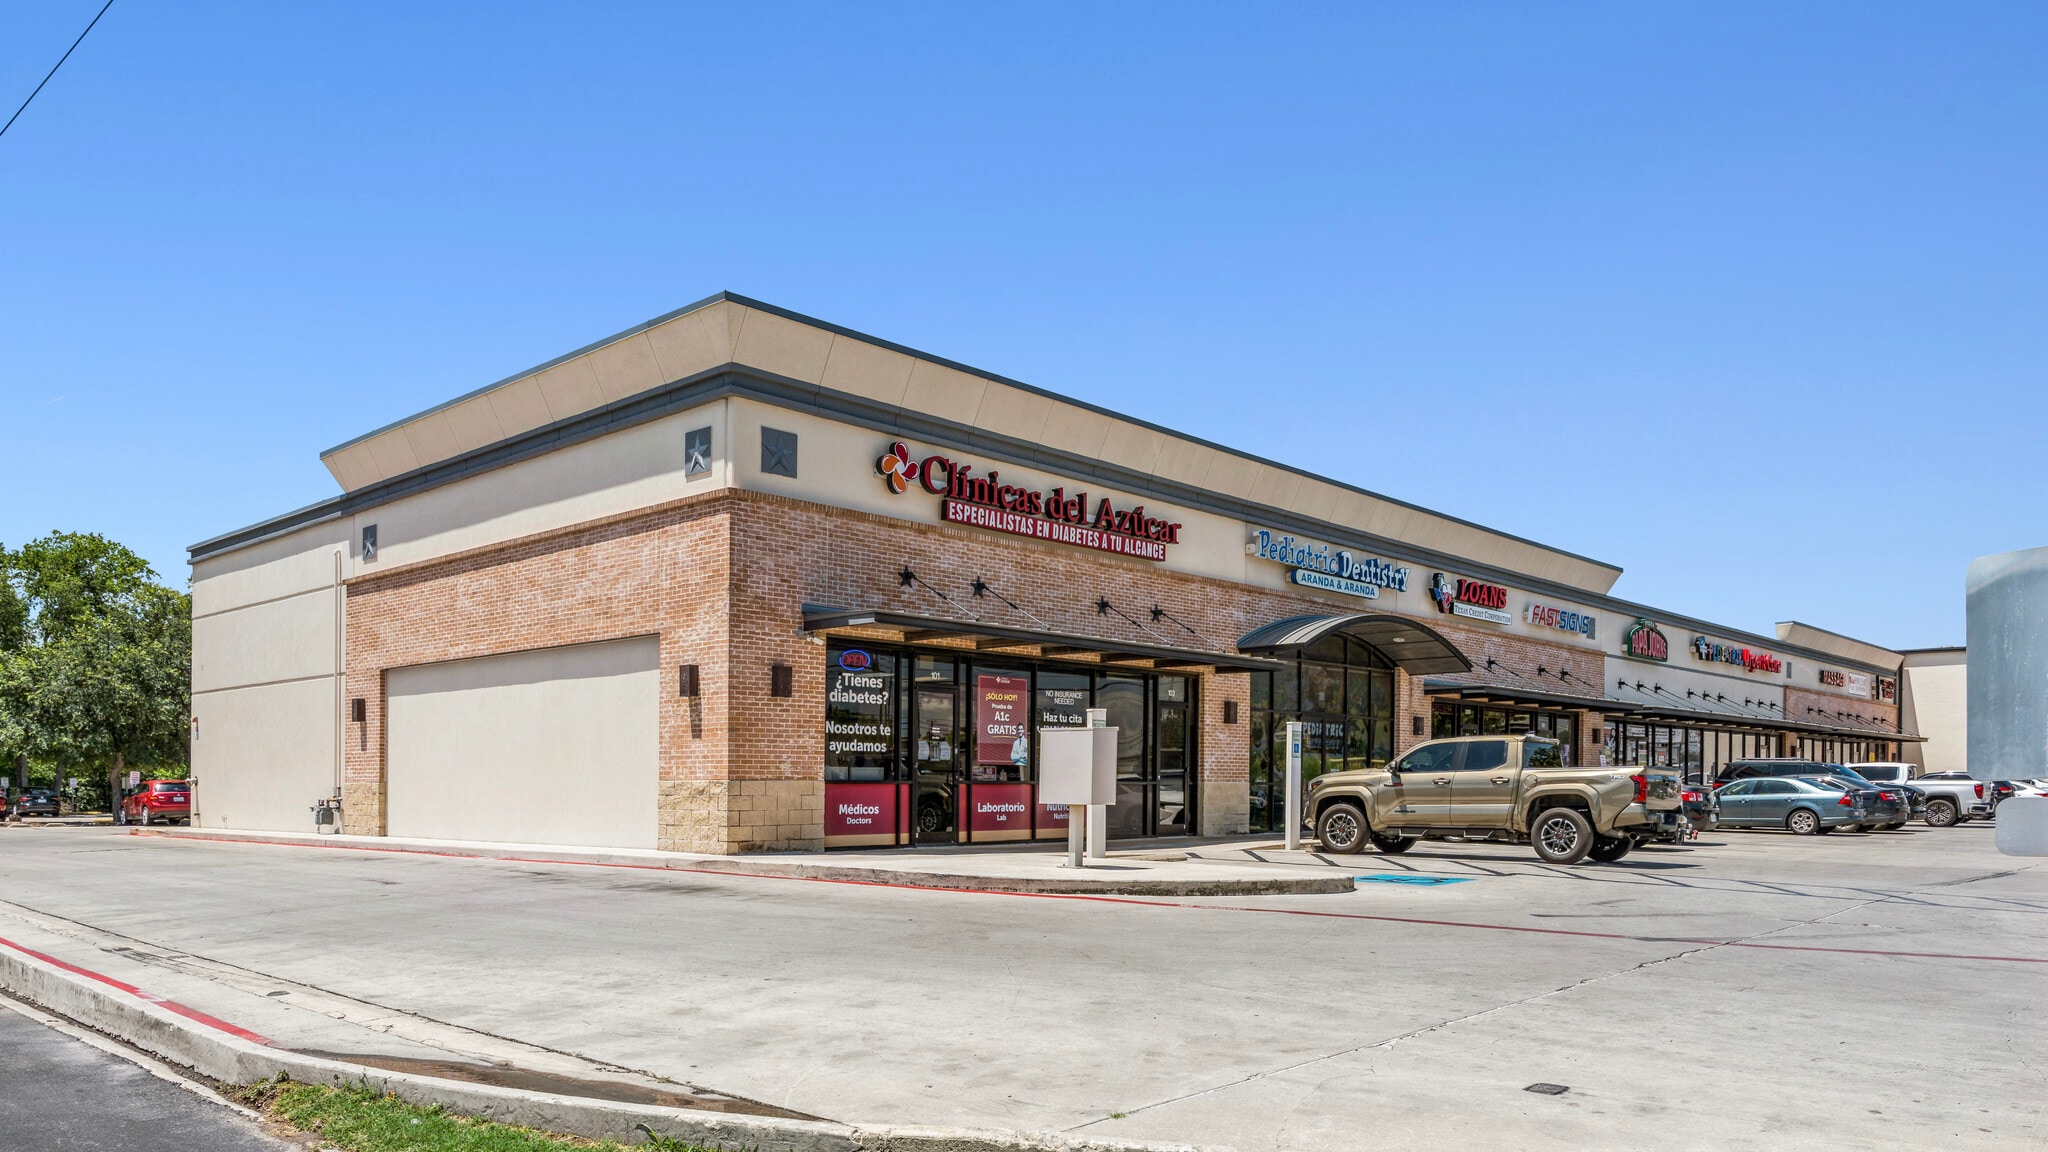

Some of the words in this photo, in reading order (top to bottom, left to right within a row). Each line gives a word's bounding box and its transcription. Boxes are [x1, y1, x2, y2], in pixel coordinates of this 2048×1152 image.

[921, 456, 1042, 514] Clínicas
[1046, 487, 1087, 525] del
[1094, 498, 1182, 544] Azúcar
[949, 502, 1033, 534] ESPECIALISTAS
[1036, 520, 1049, 538] EN
[1052, 524, 1099, 547] DIABETES
[1101, 534, 1108, 549] A
[1111, 535, 1121, 551] TU
[1124, 538, 1163, 559] ALCANCE
[1258, 529, 1338, 575] Pediatric
[1338, 551, 1411, 592] Dentistry
[1300, 572, 1334, 589] ARANDA
[1336, 580, 1343, 590] &
[1344, 584, 1375, 597] ARANDA
[1458, 579, 1507, 609] LOANS
[1532, 604, 1590, 634] FASTSIGNS
[842, 654, 867, 667] OPEN
[836, 673, 883, 688] ¿Tienes
[829, 689, 888, 704] diabetes?
[1054, 691, 1083, 699] INSURANCE
[994, 711, 1010, 722] A1c
[1043, 712, 1058, 723] Haz
[1059, 714, 1067, 723] tu
[1068, 714, 1083, 723] cita
[825, 720, 877, 735] Nosotros
[880, 724, 891, 735] te
[987, 724, 1017, 735] GRATIS
[829, 739, 887, 754] ayudamos
[838, 804, 880, 814] Médicos
[977, 802, 1025, 813] Laboratorio
[1046, 803, 1070, 811] Nutric
